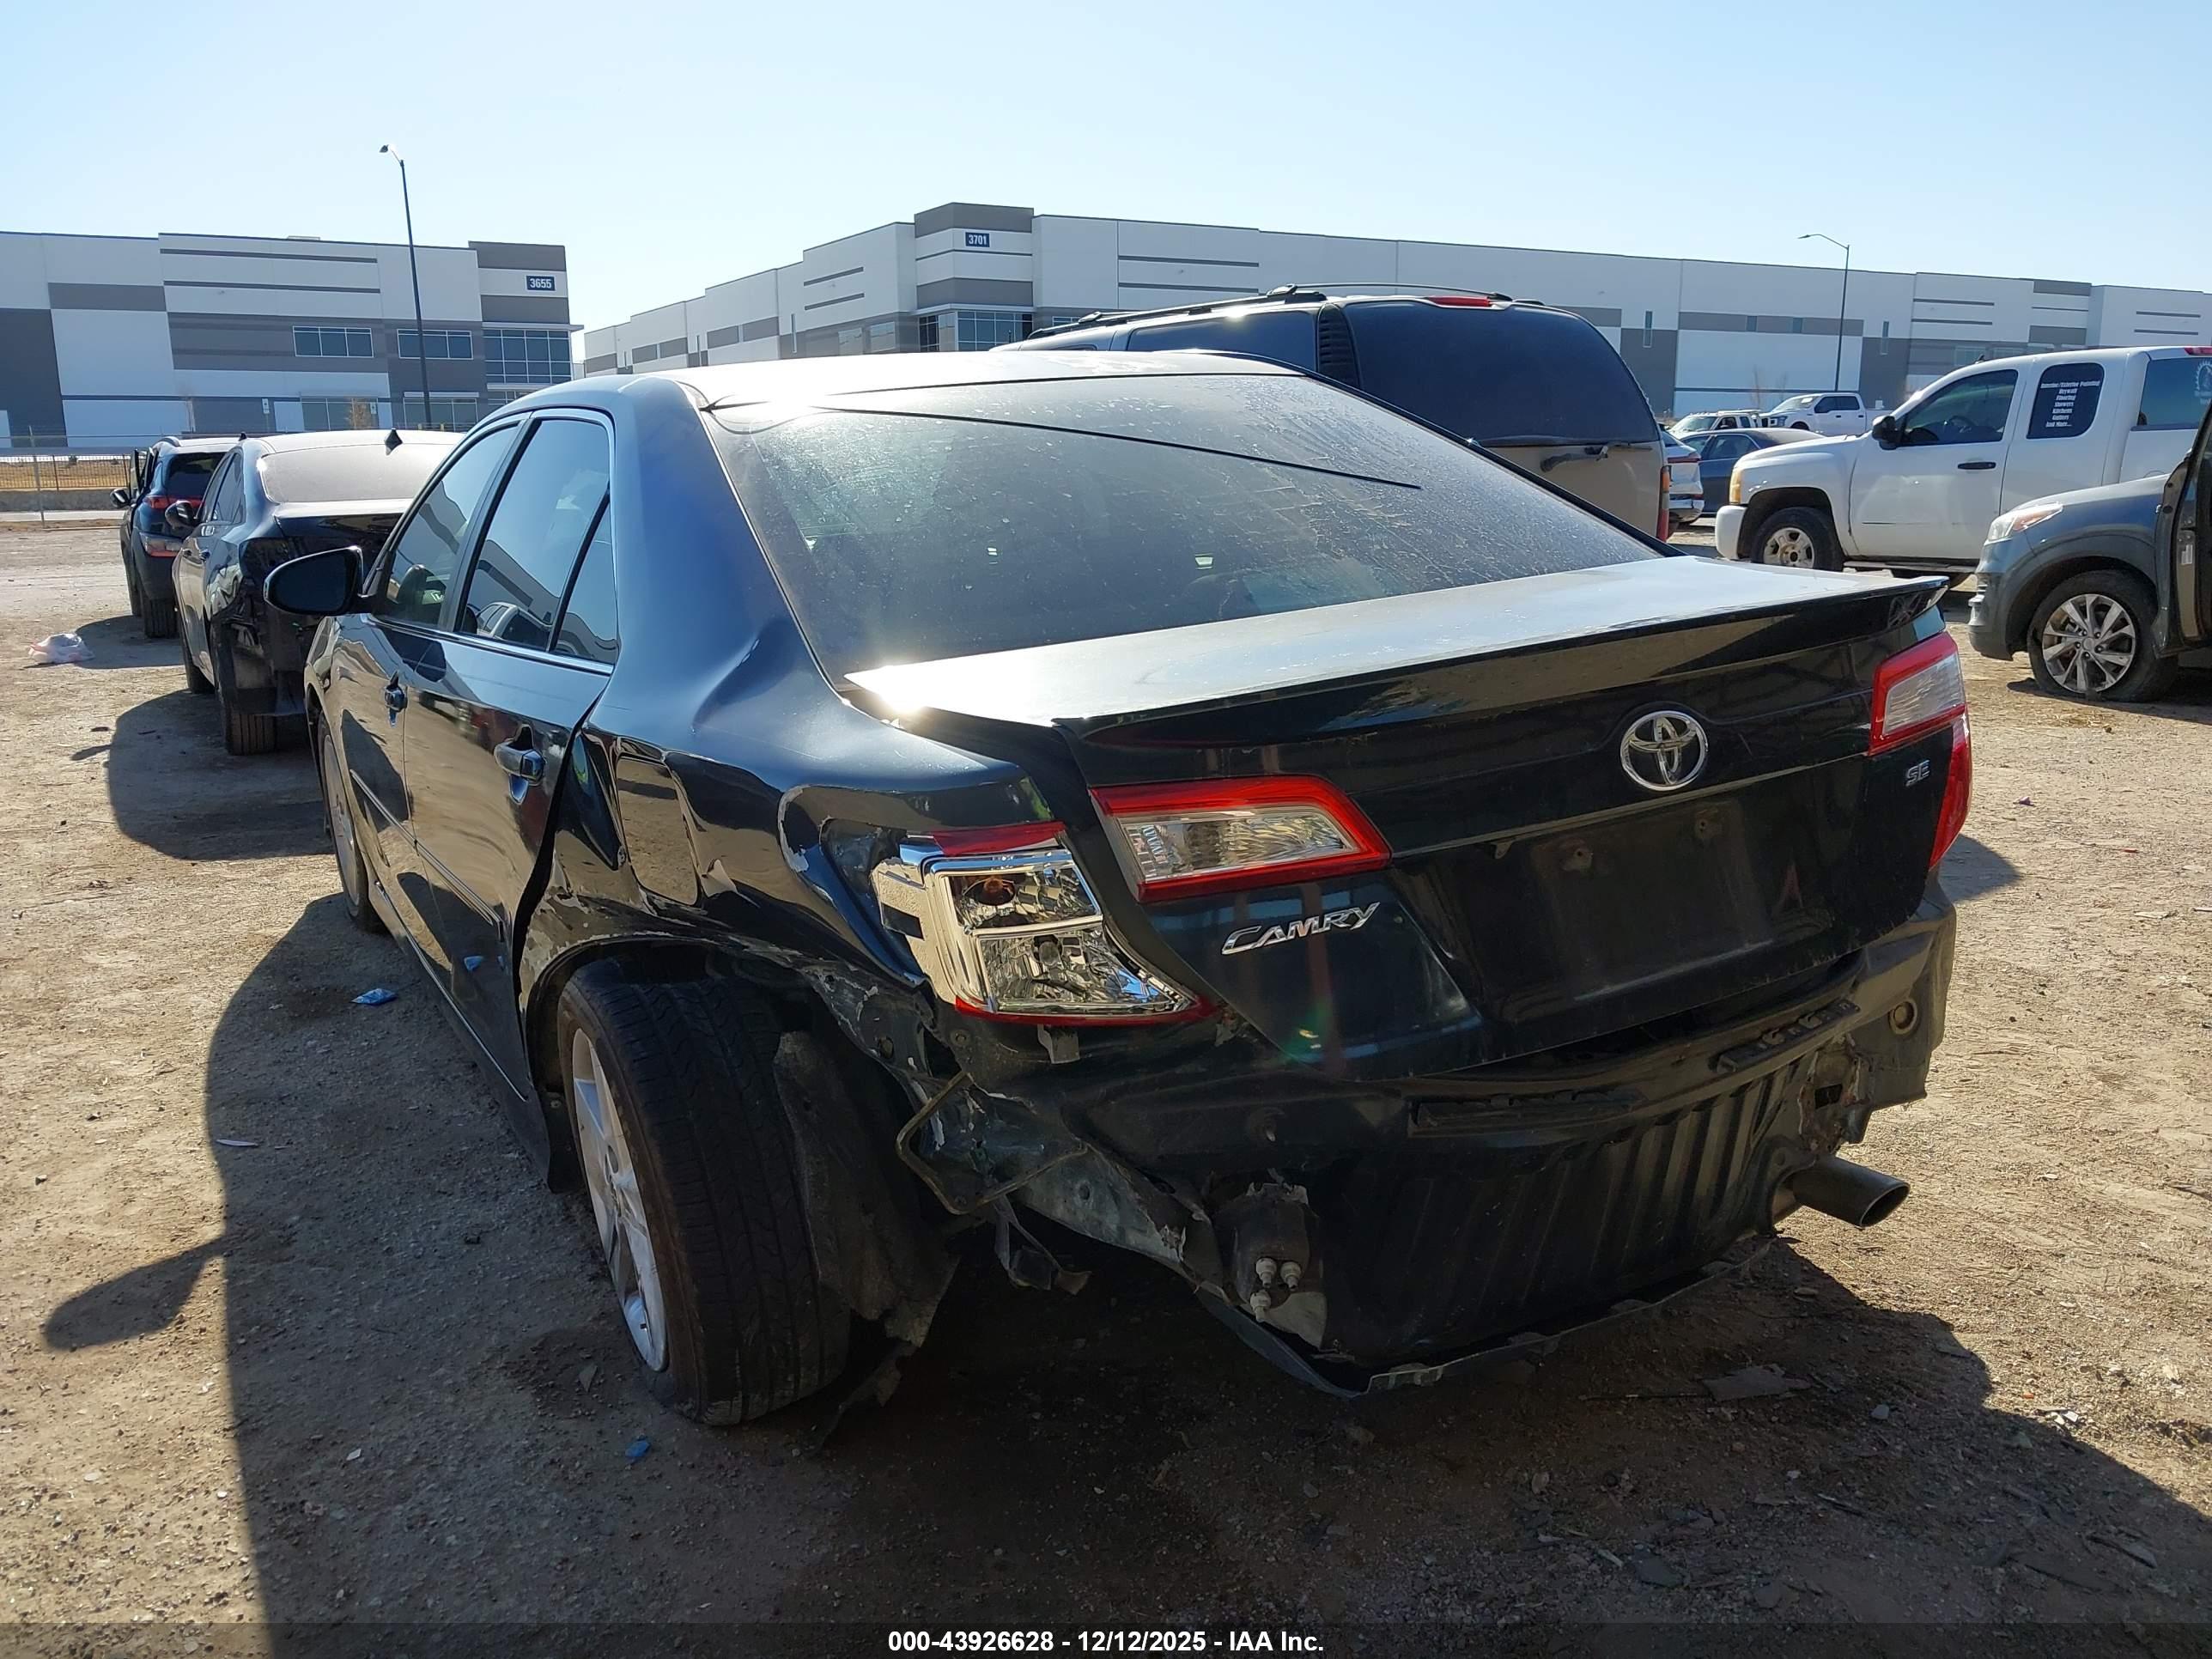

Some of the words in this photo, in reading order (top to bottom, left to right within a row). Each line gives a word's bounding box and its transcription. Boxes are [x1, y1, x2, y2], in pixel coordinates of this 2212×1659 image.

[969, 234, 987, 245] 3701
[530, 278, 552, 289] 3655
[1905, 759, 1930, 787] SE
[1221, 902, 1381, 955] CAMRY
